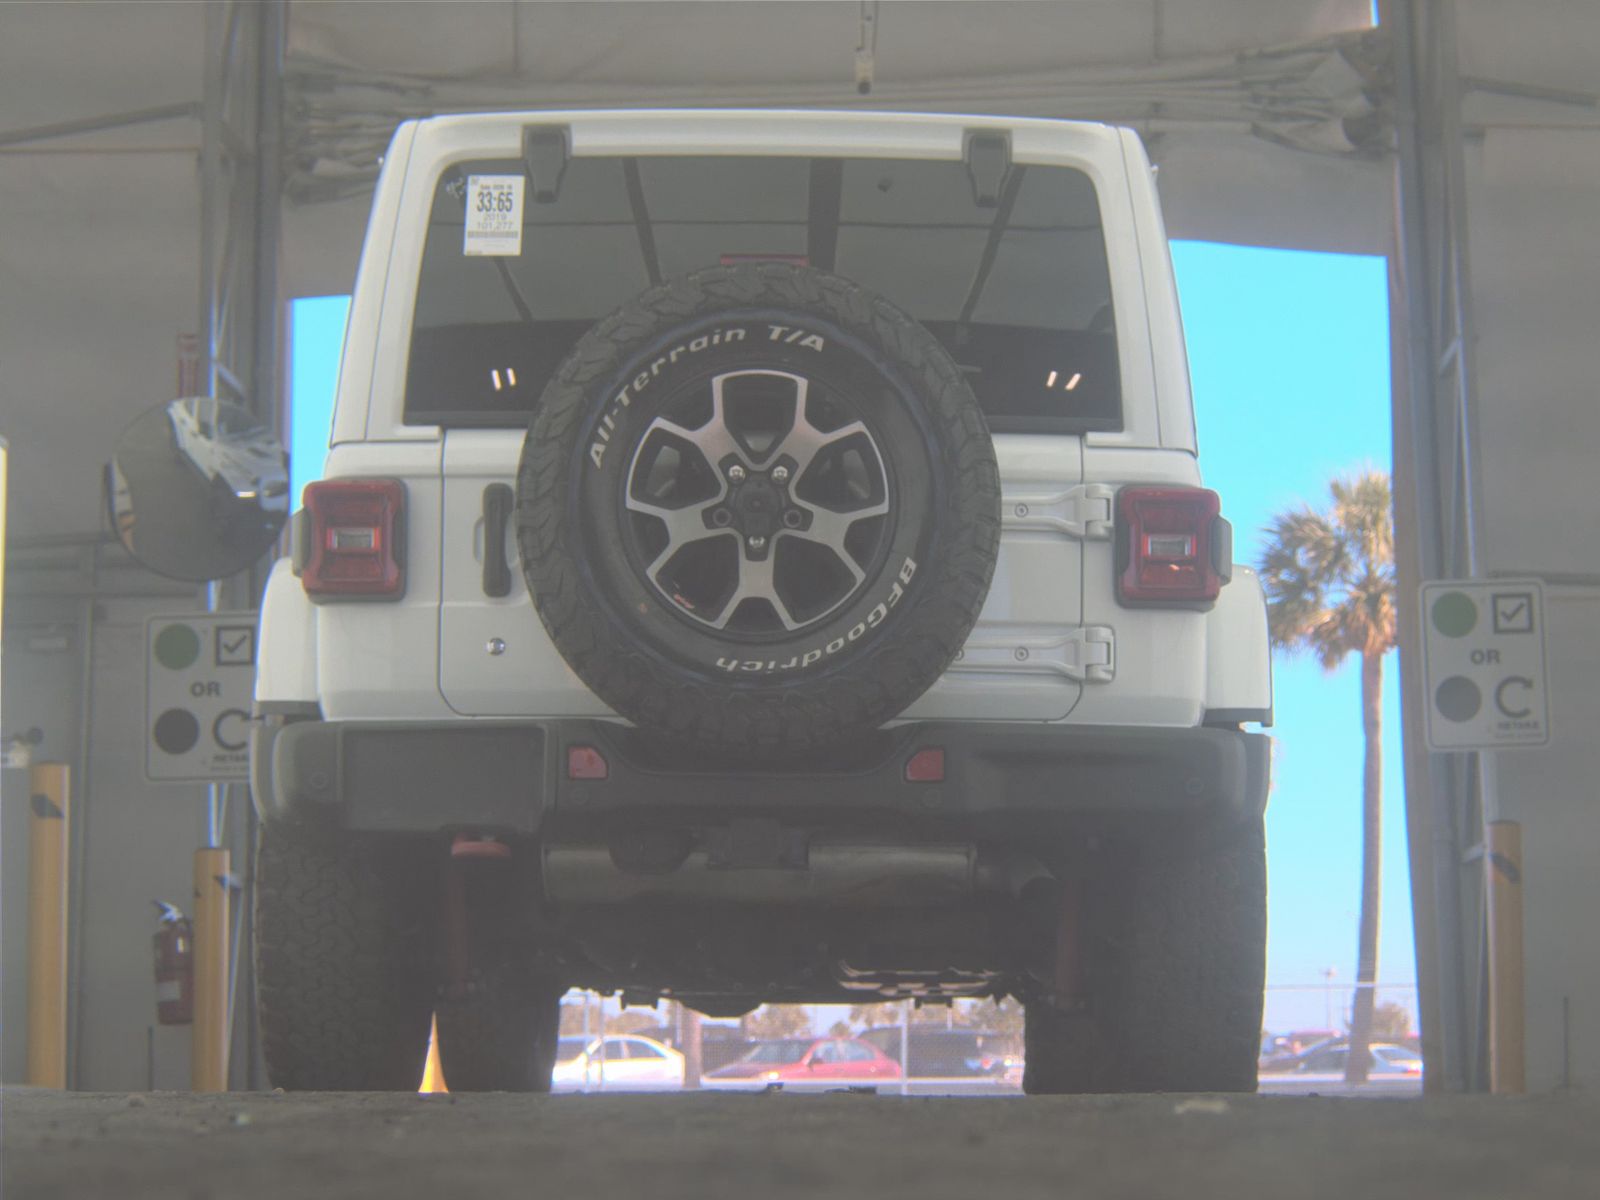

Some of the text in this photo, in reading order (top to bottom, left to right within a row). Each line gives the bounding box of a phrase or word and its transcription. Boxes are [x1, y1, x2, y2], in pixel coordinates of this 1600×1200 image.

[477, 191, 513, 212] 33:65
[590, 324, 825, 469] All-Terrain T/A
[716, 557, 918, 675] BFGoodrich
[1470, 650, 1501, 665] OR
[191, 681, 221, 697] OR
